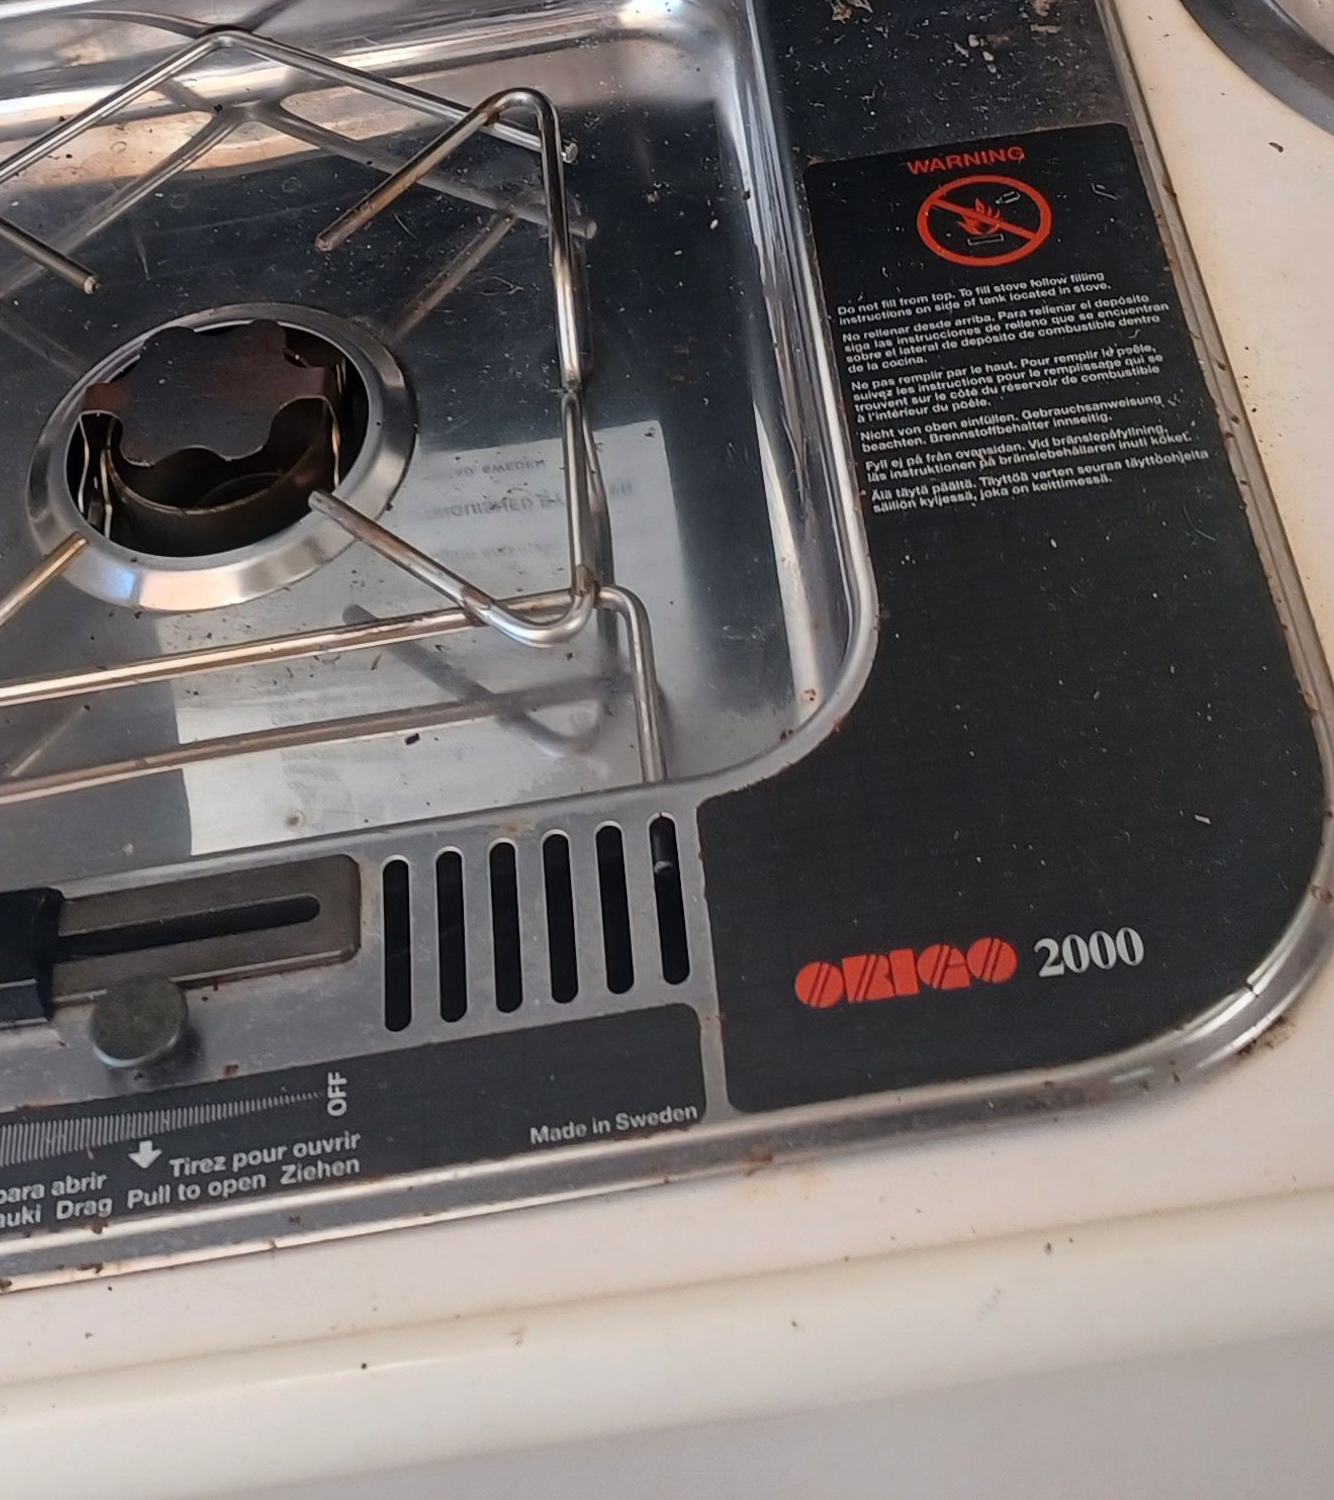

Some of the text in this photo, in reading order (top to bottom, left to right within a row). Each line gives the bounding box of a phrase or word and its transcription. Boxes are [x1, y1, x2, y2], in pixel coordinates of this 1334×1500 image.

[907, 146, 1025, 175] WARNING
[1034, 927, 1145, 978] 2000
[327, 1072, 348, 1117] OFF
[530, 1102, 699, 1145] Made in Sweden
[170, 1130, 361, 1178] Tirez pour ouvrir
[280, 1157, 361, 1186] Ziehen
[51, 1172, 108, 1196] abrir
[127, 1173, 267, 1209] Pull to open
[56, 1197, 113, 1220] Drag
